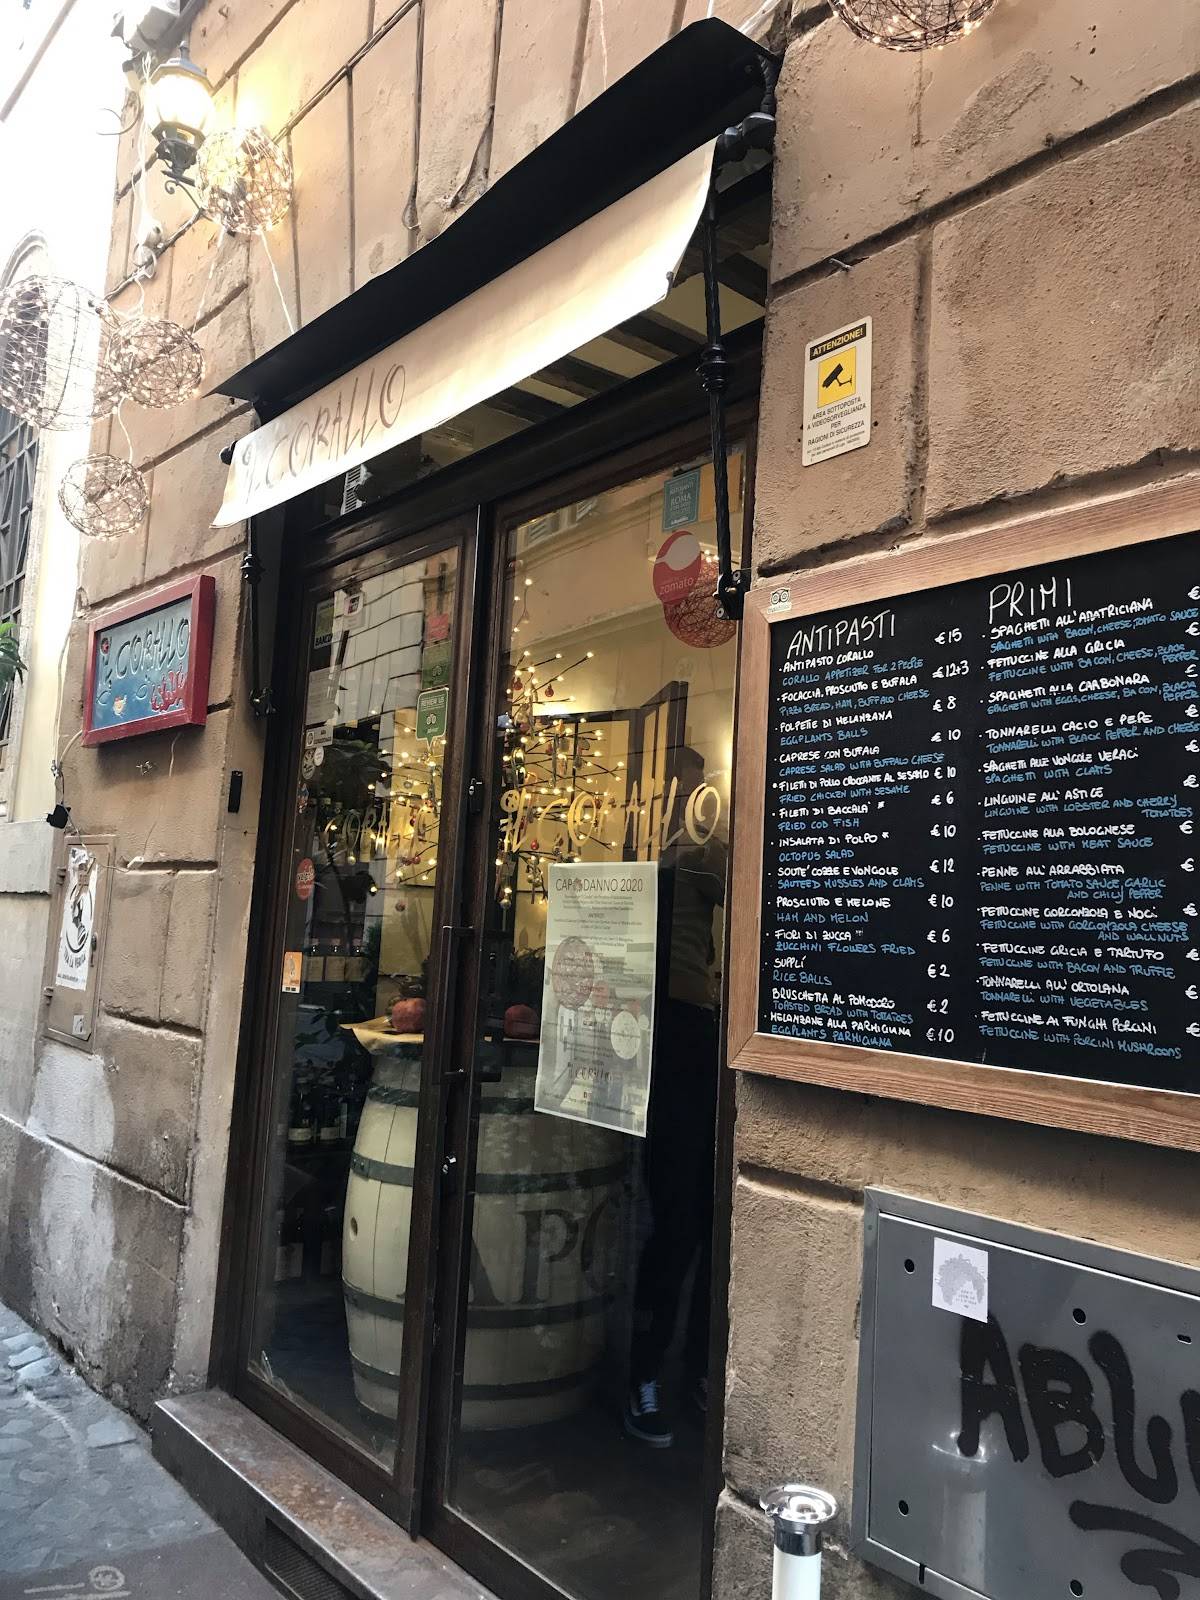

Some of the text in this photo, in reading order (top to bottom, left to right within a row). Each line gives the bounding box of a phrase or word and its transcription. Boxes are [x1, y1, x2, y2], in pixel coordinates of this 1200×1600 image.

[812, 328, 863, 357] ATTENZIONE!
[812, 396, 861, 420] AREA SOTTOPOSTA
[812, 403, 866, 428] VIDEOSORVEGLIANZA
[265, 364, 406, 488] CORALLO
[808, 434, 829, 446] RAGIONI
[836, 420, 865, 436] SICUREZZA
[831, 421, 841, 429] PER
[659, 576, 694, 595] zomato
[989, 577, 1071, 624] PRIMI
[787, 609, 896, 659] ANTIPASTI
[990, 617, 1050, 640] SPAGHETTI
[990, 608, 1199, 653] SPAGHETTI WITH SAUCE
[116, 617, 191, 679] CORALLO
[987, 639, 1125, 670] FETTUCCINE ALLA GRICIA
[783, 650, 874, 673] ANTIPASTO CORALLO
[783, 664, 889, 686] CORALLO APPETIZER FOR
[988, 662, 1074, 682] FETTUCCINE WITH
[826, 675, 917, 697] PROSCIUTTO E BUFALA
[988, 673, 1150, 703] SPAGHETTI ALLA CARBONARA
[859, 689, 930, 707] BUFFALO CHEESE
[780, 711, 893, 733] POLPETTE DI MELANZANA
[985, 711, 1154, 740] TONNARELLI CACIO E PEPE
[781, 728, 868, 746] EGGPLANTS BALLS
[1041, 725, 1166, 747] WITH AND
[779, 747, 880, 763] CAPRESE CON BUFALA
[983, 747, 1139, 773] SPAGHETTI VERACI
[779, 753, 944, 777] CAPRESE SALAD WITH BUFFALO CHEESE
[984, 764, 1113, 784] SPAGHETTI WITH CLAMS
[809, 773, 895, 789] DI POLLO AL
[779, 785, 910, 804] FRIED CHICKEN WITH SESAME
[984, 787, 1104, 807] LINGUINE ASTICE
[814, 807, 824, 815] DI
[984, 795, 1178, 818] LINGUINE WITH LOBSTER AND CHERRY
[778, 818, 859, 831] FRIED COD FISH
[1043, 824, 1135, 837] ALLA BOLOGNESE
[779, 834, 878, 847] INSALATA DI POLPO
[1048, 837, 1154, 851] WITH SAUCE
[779, 849, 854, 862] OCTOPUS SALAD
[843, 866, 899, 876] E VONGOLE
[981, 864, 1125, 877] PENNE ARRABBIATA
[621, 879, 643, 892] 2020
[778, 878, 924, 890] SAUTEED AND CLAMS
[980, 877, 1166, 892] PENNE WITH GARLIC
[776, 897, 891, 908] PROSCIUTTO E MELONE
[1066, 891, 1089, 900] AND
[777, 913, 870, 923] HAM AND MELON
[1114, 909, 1123, 919] E
[775, 930, 852, 941] FIORI DI ZUCCA
[1040, 922, 1189, 932] WITH CHEESE
[1097, 932, 1120, 941] AND
[775, 941, 916, 955] ZUCCHINI FLOWERS FRIED
[1050, 945, 1164, 960] GRICIA E TARTUFO
[773, 971, 832, 985] RICE BALLS
[1037, 961, 1176, 980] WITH BACON AND TRUFFLE
[1071, 981, 1130, 996] ORTOLANA
[772, 988, 896, 1009] BRUSCHETTA AL POMODORO
[1039, 995, 1065, 1005] WITH
[773, 1000, 869, 1019] TOASTED BREAD WITH
[770, 1012, 848, 1030] MELANZANE ALLA
[1046, 1016, 1157, 1035] AI FUNGHI PORCINI
[1044, 1032, 1114, 1050] WITH PORCINI
